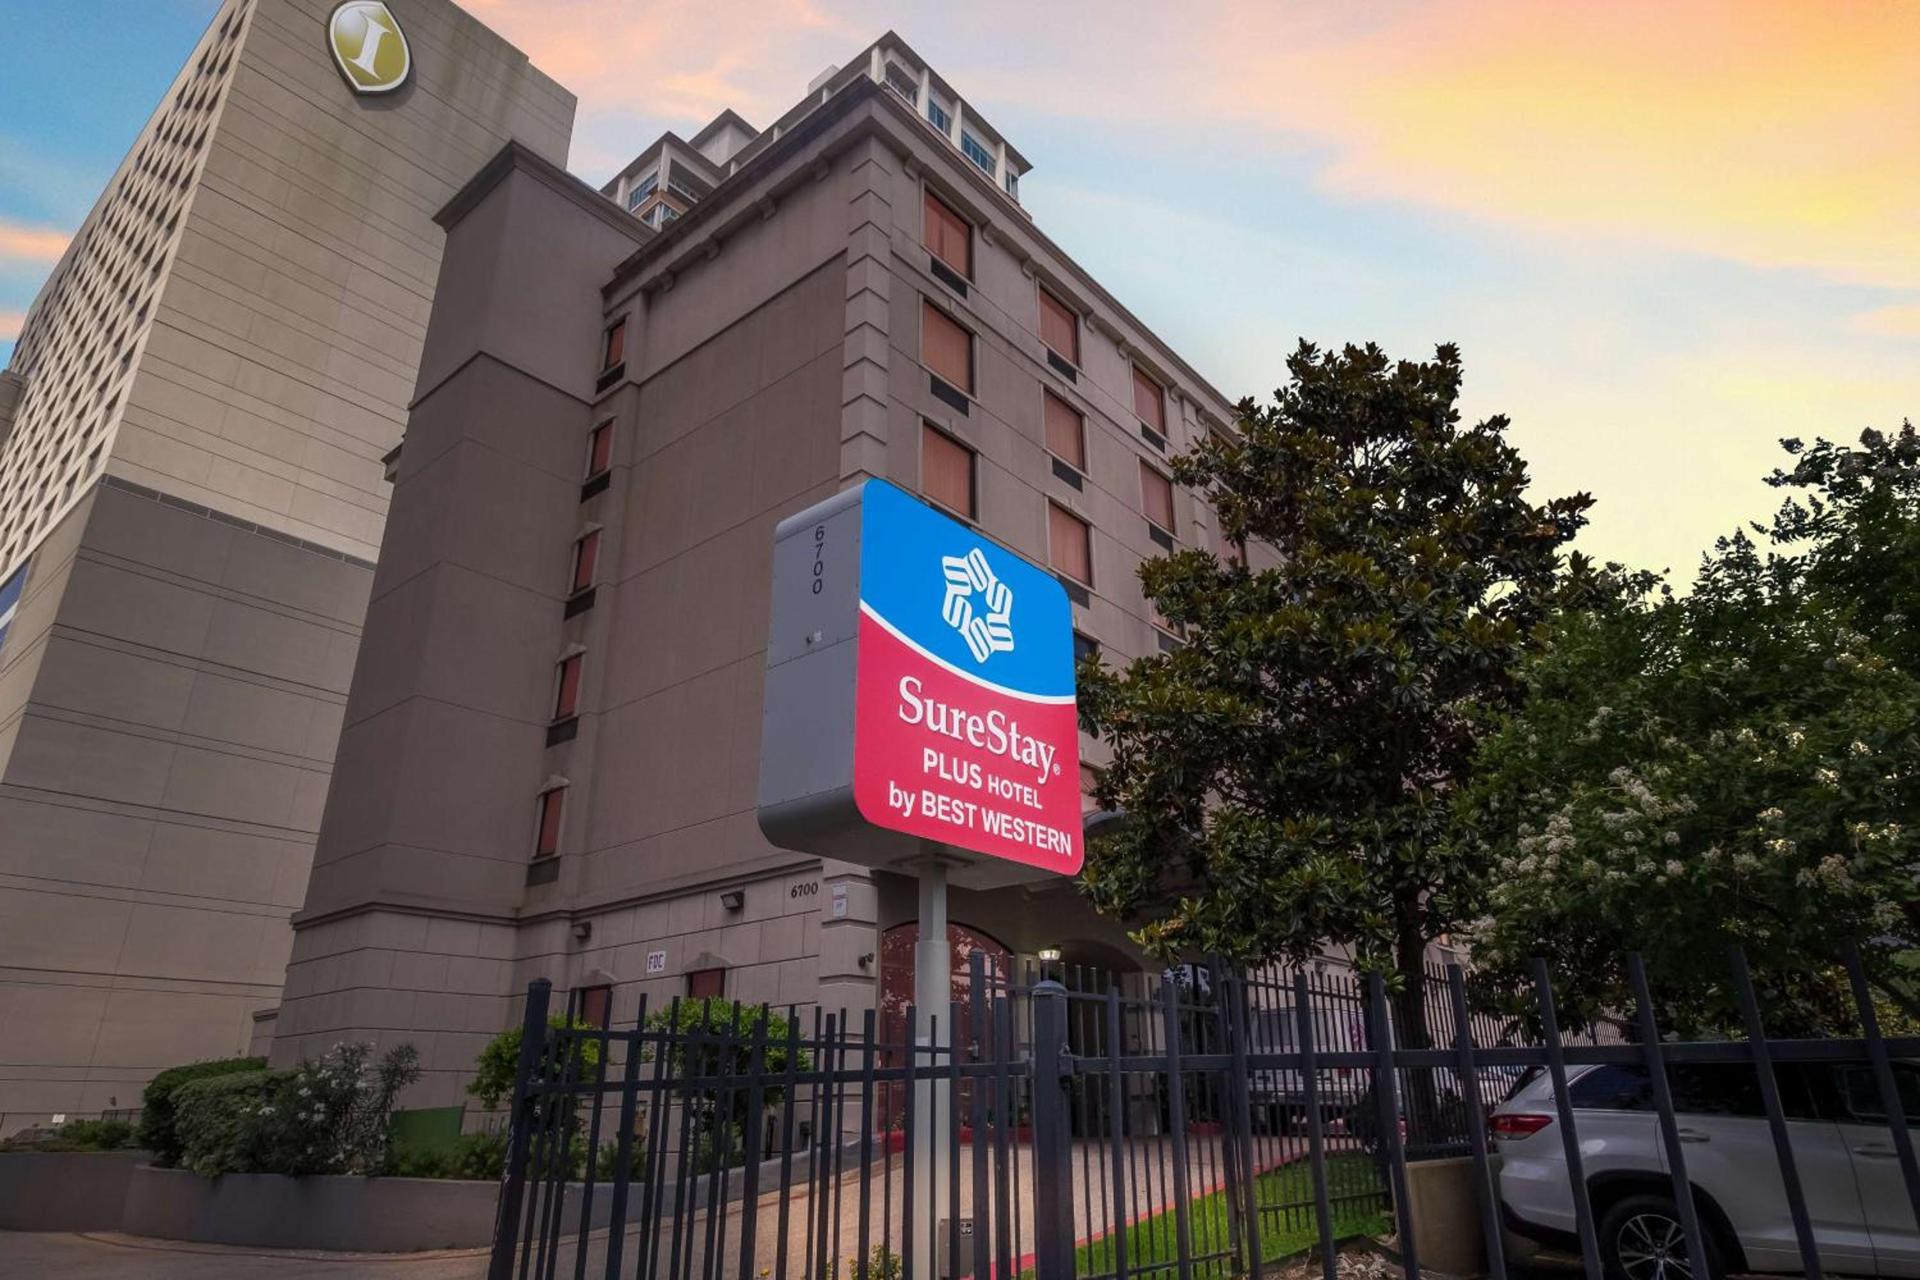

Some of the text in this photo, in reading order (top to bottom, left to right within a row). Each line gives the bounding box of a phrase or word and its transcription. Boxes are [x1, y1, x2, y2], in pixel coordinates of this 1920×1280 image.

[812, 525, 826, 595] 6700
[923, 747, 1044, 810] PLUS HOTEL
[889, 780, 1073, 858] by BEST WESTERN
[791, 882, 819, 899] 6700
[648, 953, 664, 970] FDC
